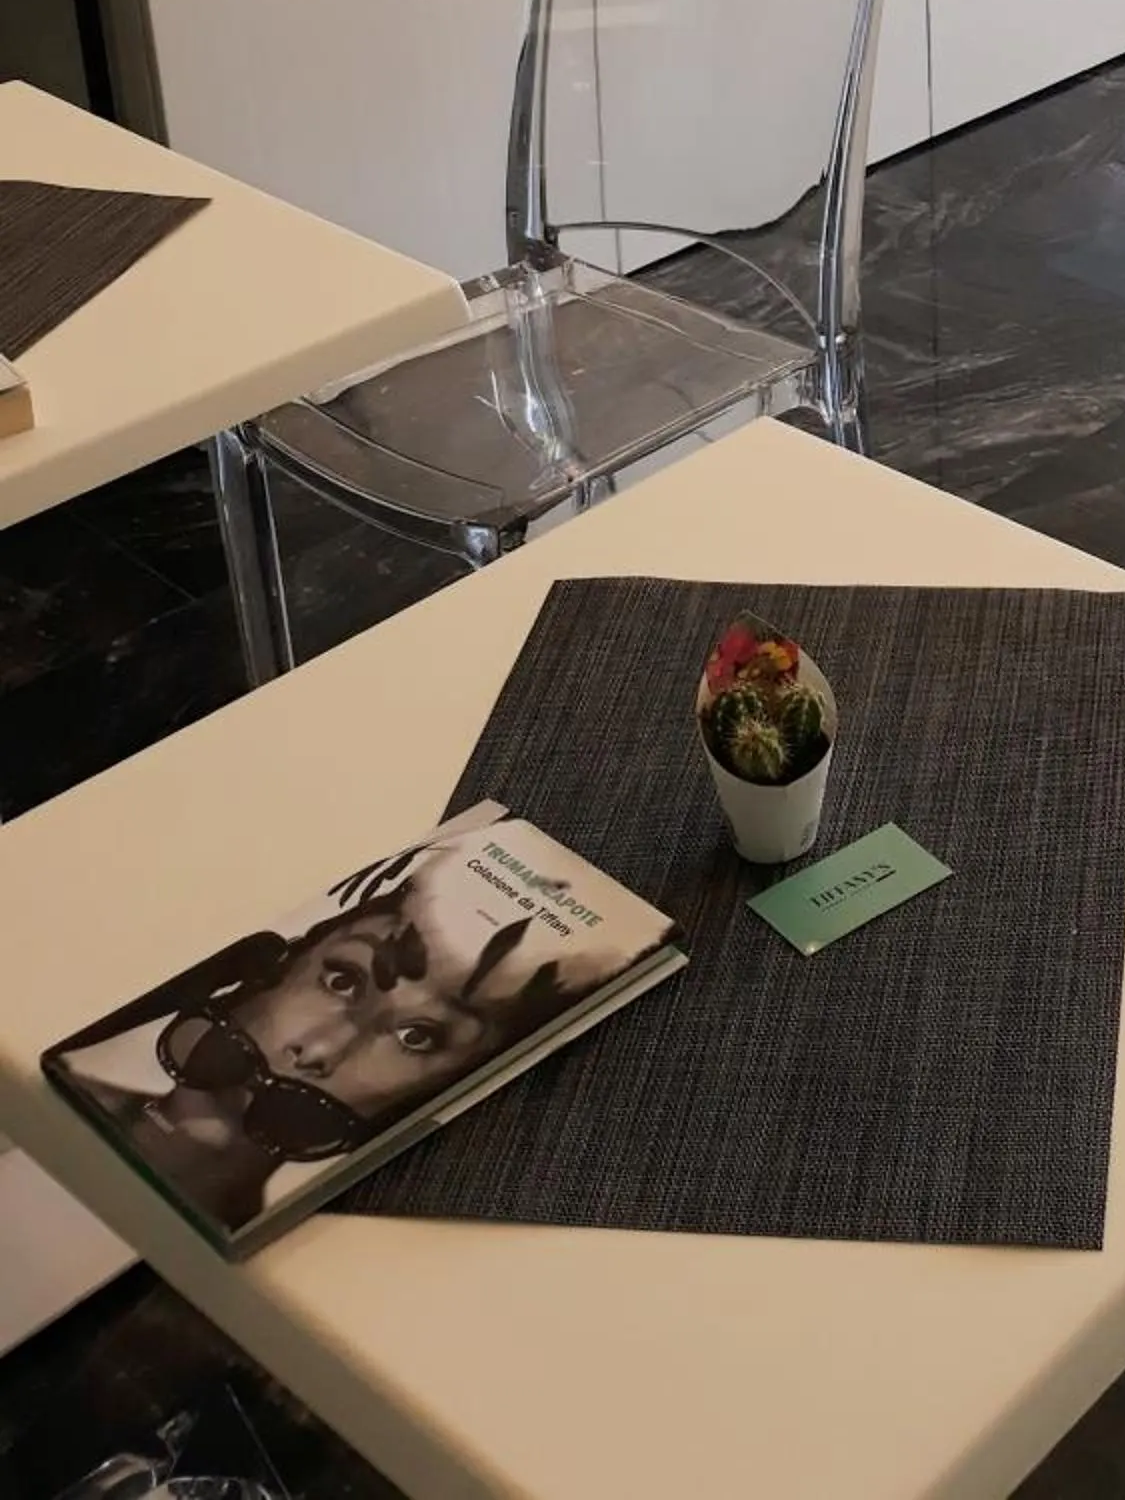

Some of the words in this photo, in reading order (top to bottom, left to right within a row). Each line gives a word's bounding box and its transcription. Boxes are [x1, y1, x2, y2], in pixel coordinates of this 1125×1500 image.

[466, 858, 519, 899] Colazione
[517, 896, 536, 911] da
[534, 906, 574, 937] Tiffany
